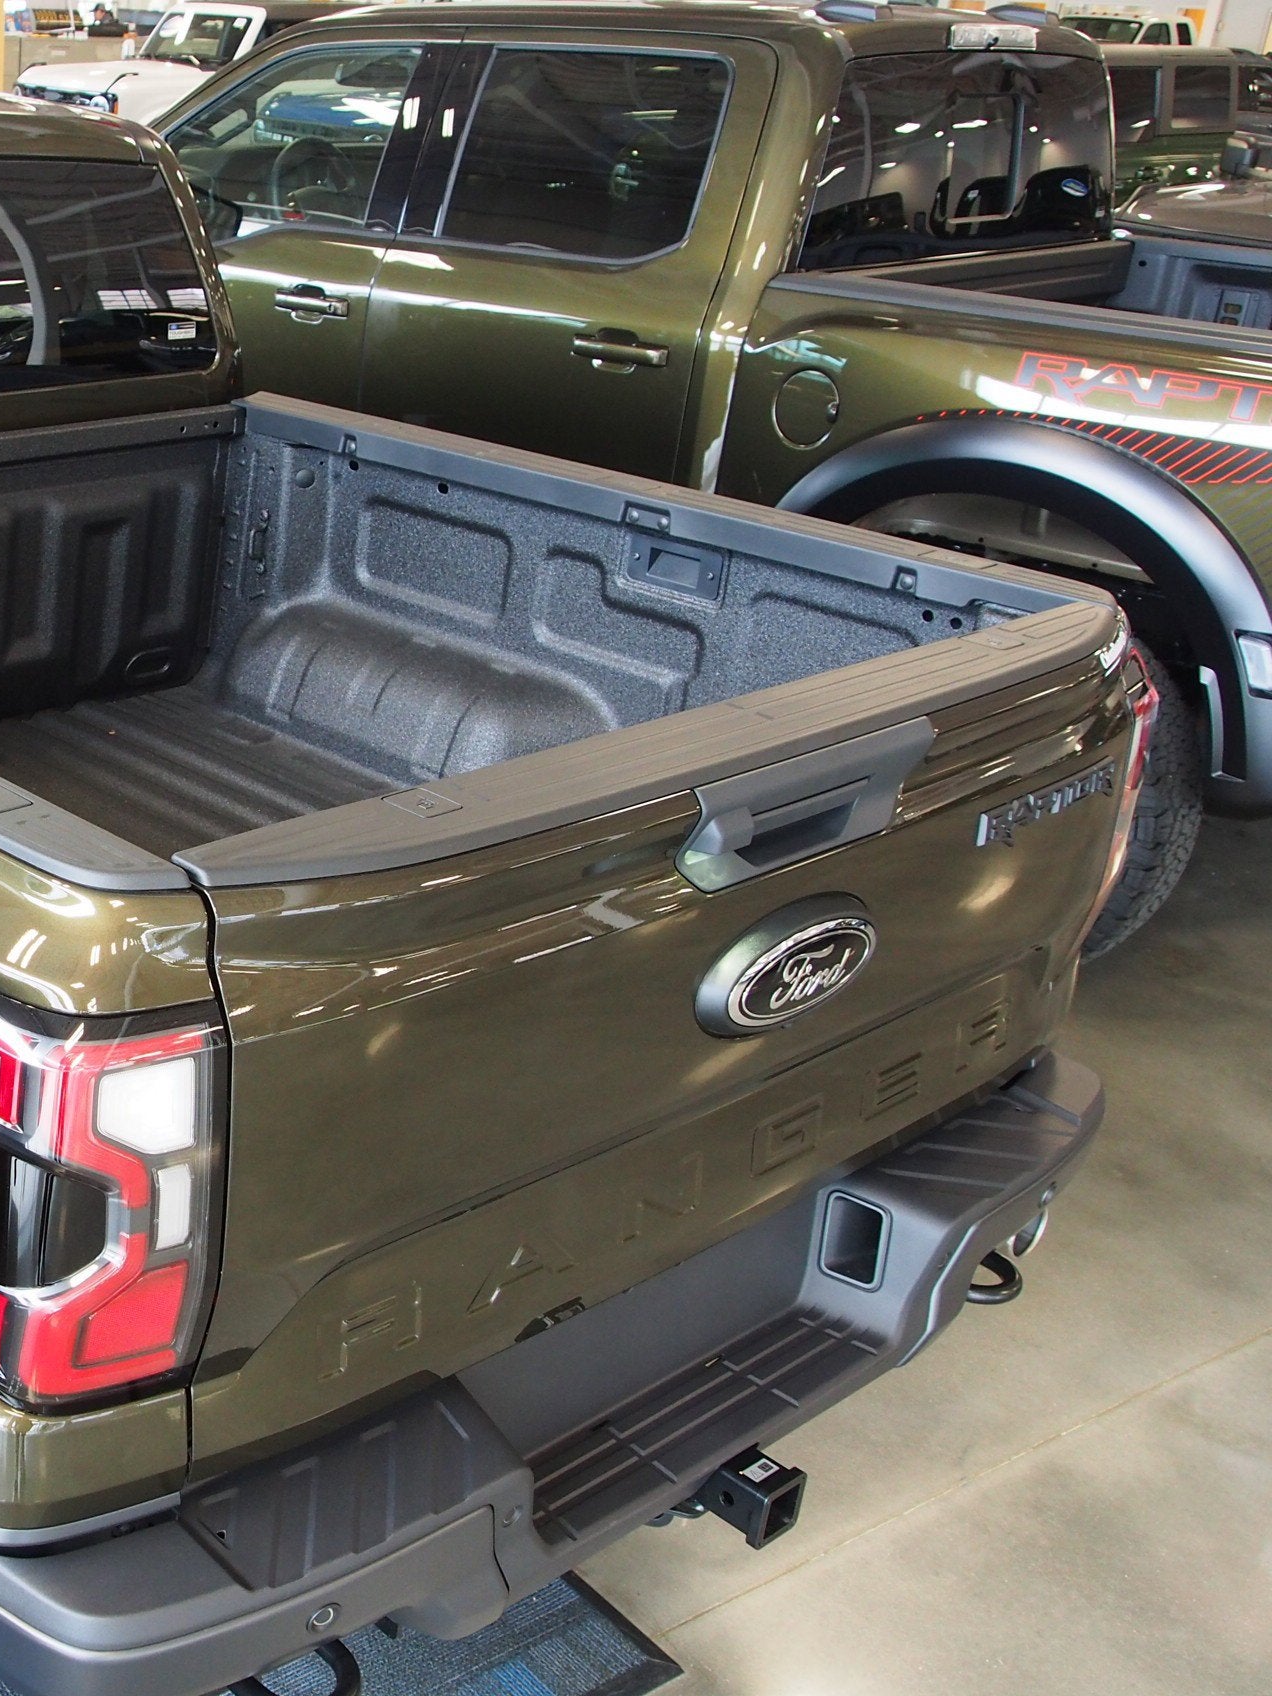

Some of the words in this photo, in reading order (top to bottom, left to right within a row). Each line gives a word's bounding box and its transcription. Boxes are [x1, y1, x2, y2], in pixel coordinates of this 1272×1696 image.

[1013, 351, 1272, 423] RAPT
[769, 943, 852, 1010] Ford
[317, 973, 1010, 1382] RANGER
